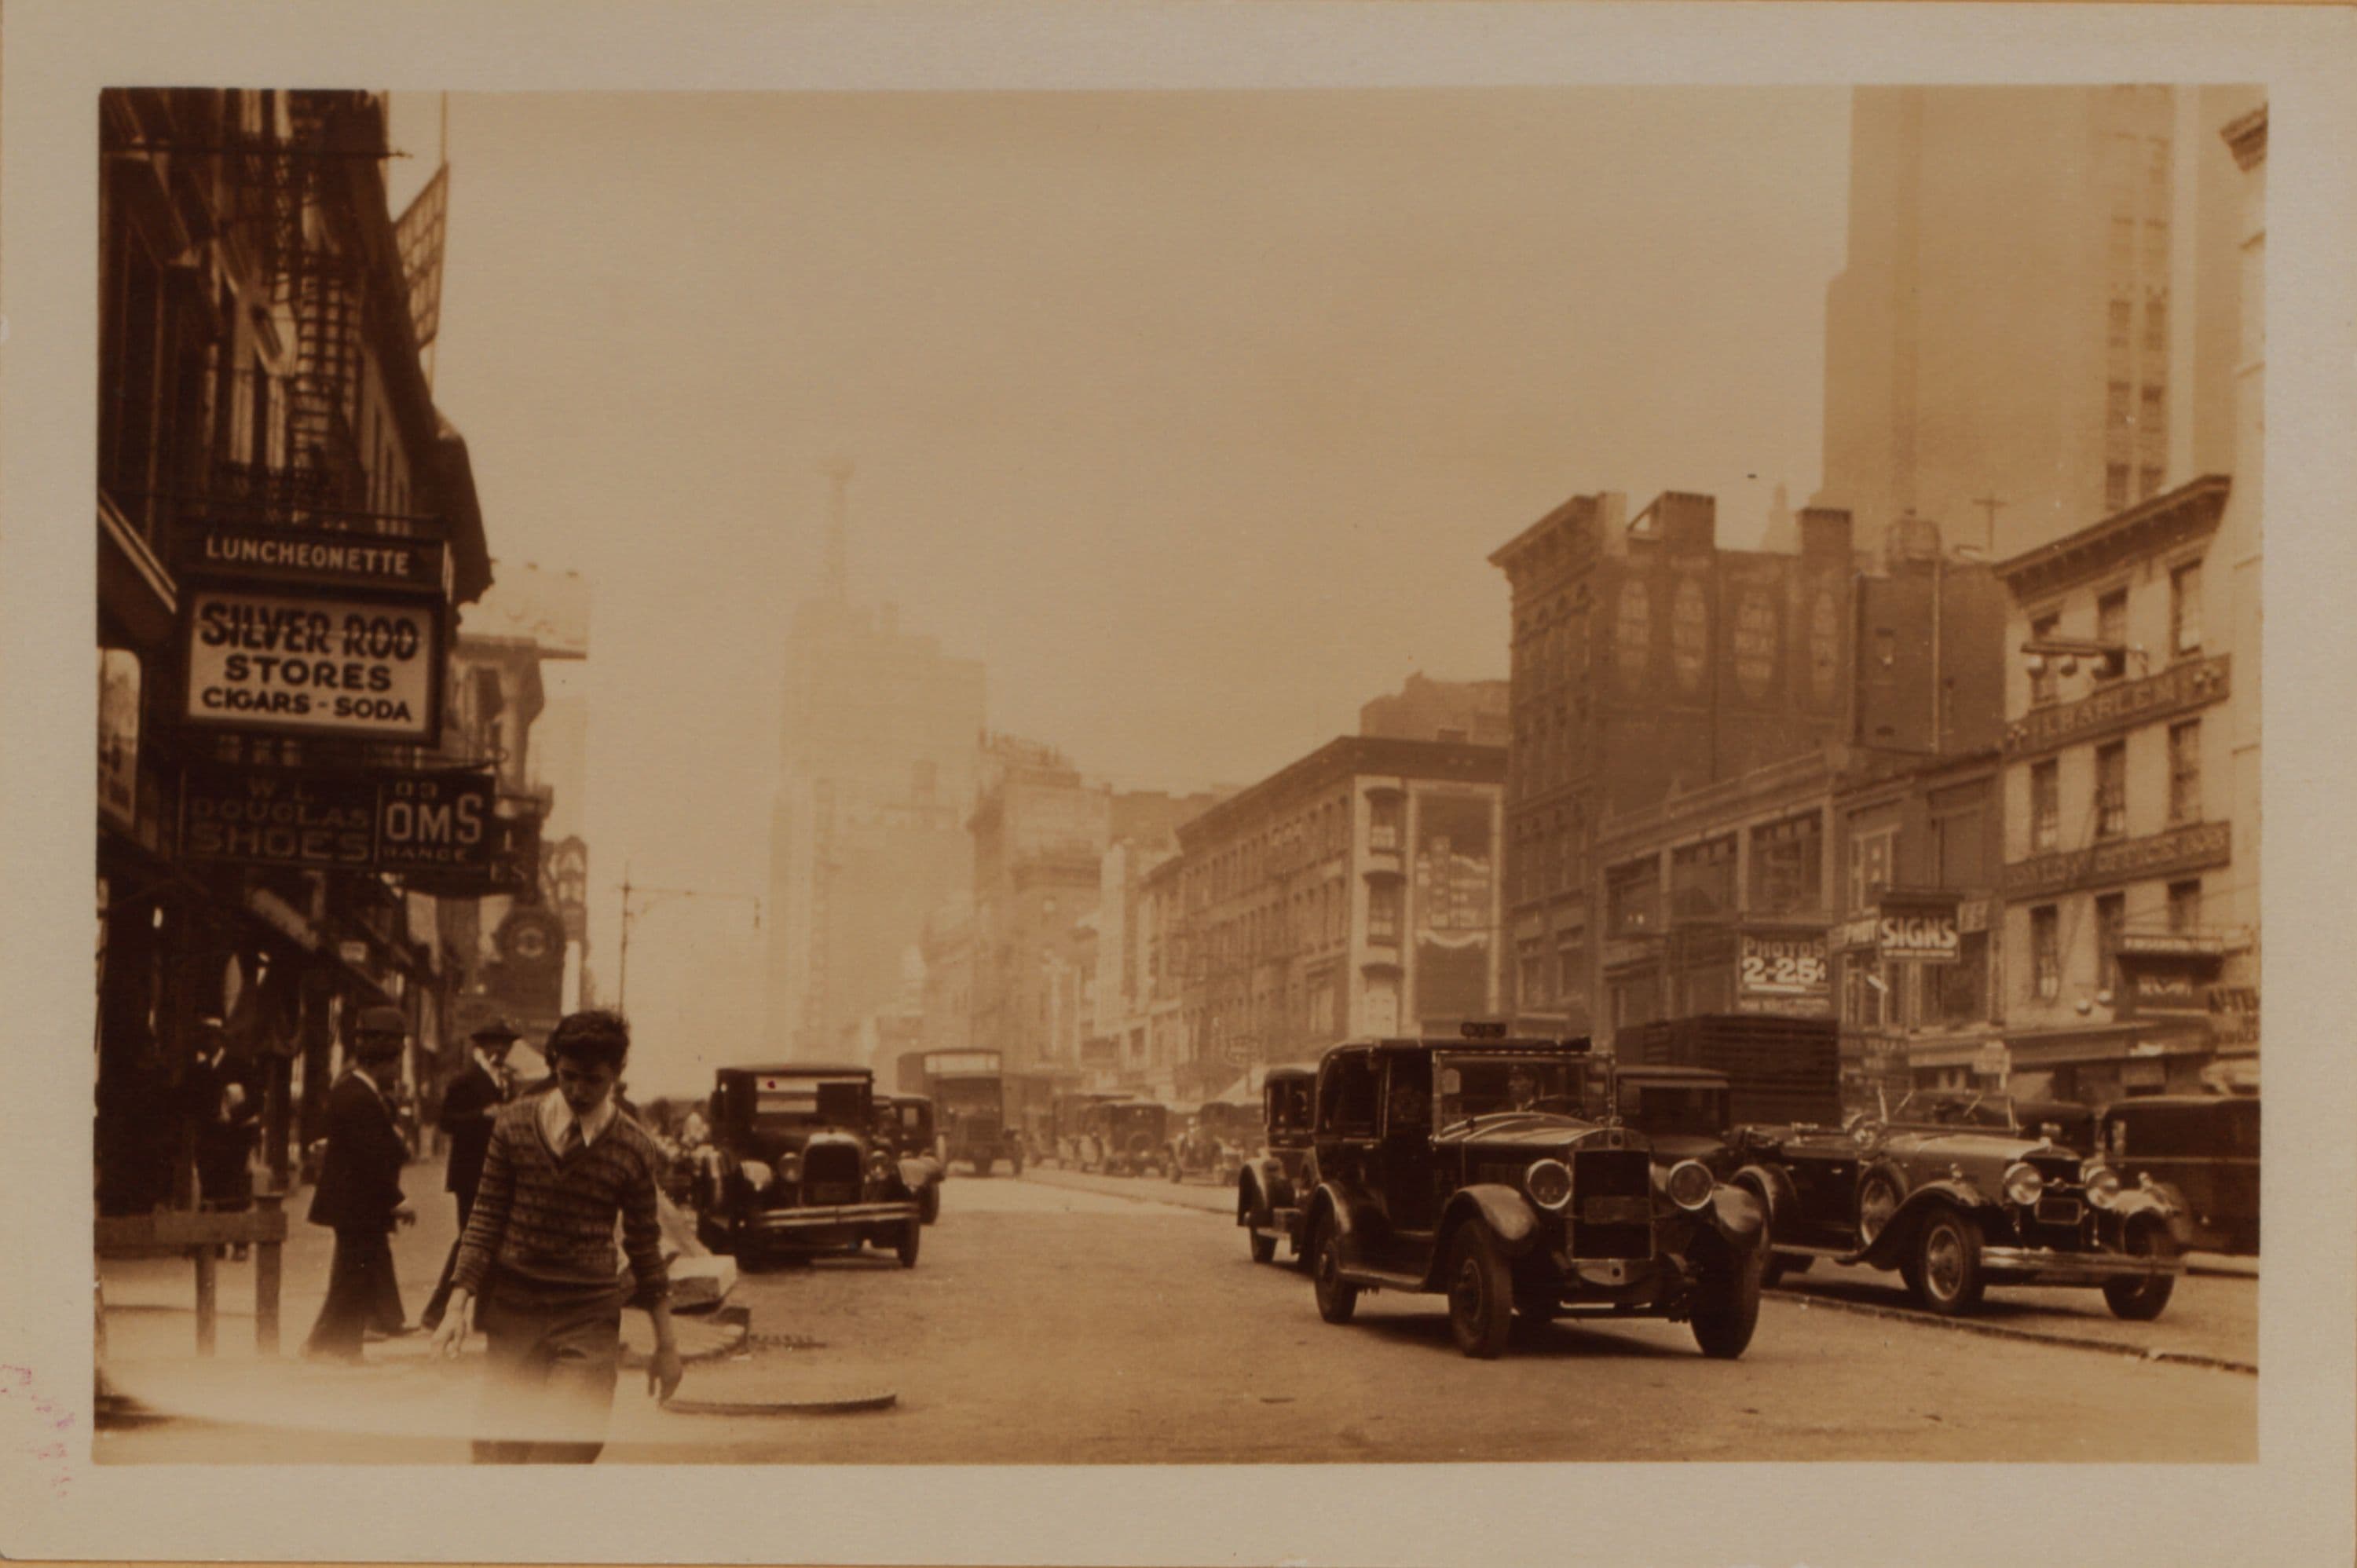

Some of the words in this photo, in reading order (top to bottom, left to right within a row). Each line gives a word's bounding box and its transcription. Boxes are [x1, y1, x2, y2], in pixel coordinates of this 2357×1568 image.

[206, 535, 410, 576] LUNCHEONETTE
[201, 602, 331, 654] SILVER
[343, 613, 419, 661] ROD
[225, 653, 392, 692] STORES
[202, 686, 310, 715] CIGARS
[334, 696, 412, 721] SODA
[189, 797, 371, 829] DOUGLAS
[386, 791, 485, 845] OMS
[189, 821, 371, 863] SHOES
[1740, 936, 1827, 959] PHOTOS
[1880, 916, 1959, 949] SIGNS
